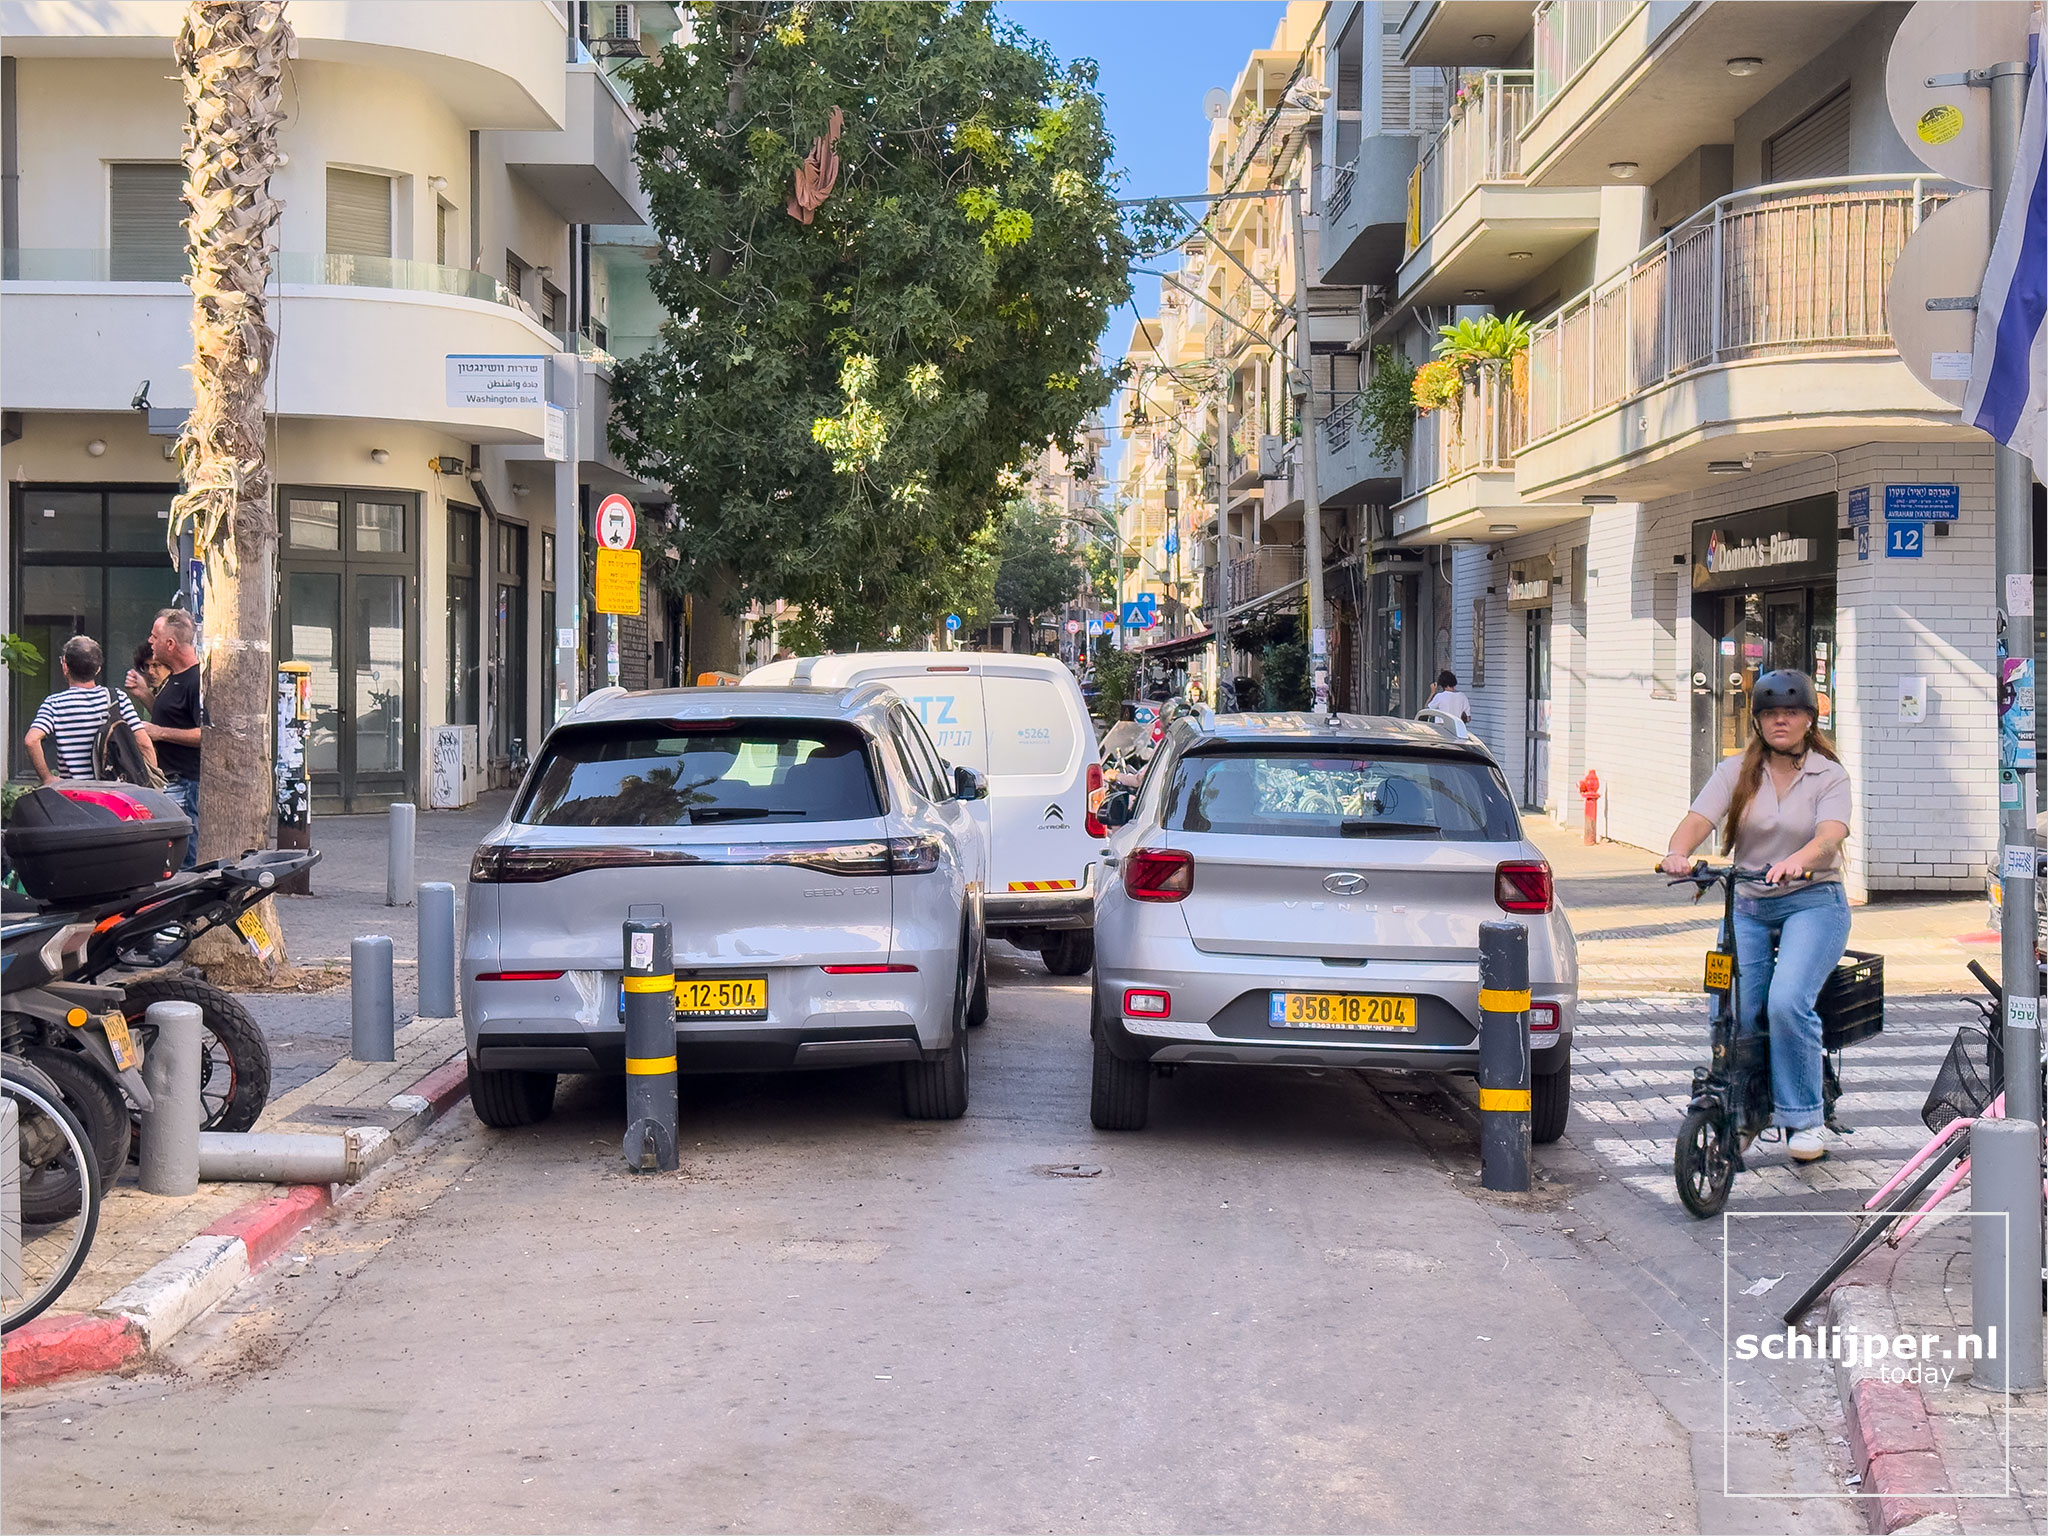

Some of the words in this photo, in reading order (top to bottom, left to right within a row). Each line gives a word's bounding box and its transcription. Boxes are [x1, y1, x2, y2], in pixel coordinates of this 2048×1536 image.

[457, 363, 504, 374] וושינגטון
[507, 364, 538, 373] שדרות
[487, 379, 521, 390] واشنطن
[522, 380, 538, 388] جادة
[466, 394, 519, 405] Washington
[1932, 511, 1950, 519] STERN
[1892, 529, 1919, 550] 12
[1718, 537, 1764, 571] Domino's
[1770, 531, 1803, 565] Pizza
[803, 887, 847, 898] GEELY
[1282, 901, 1406, 914] VENUE
[2010, 1008, 2035, 1021] שפל
